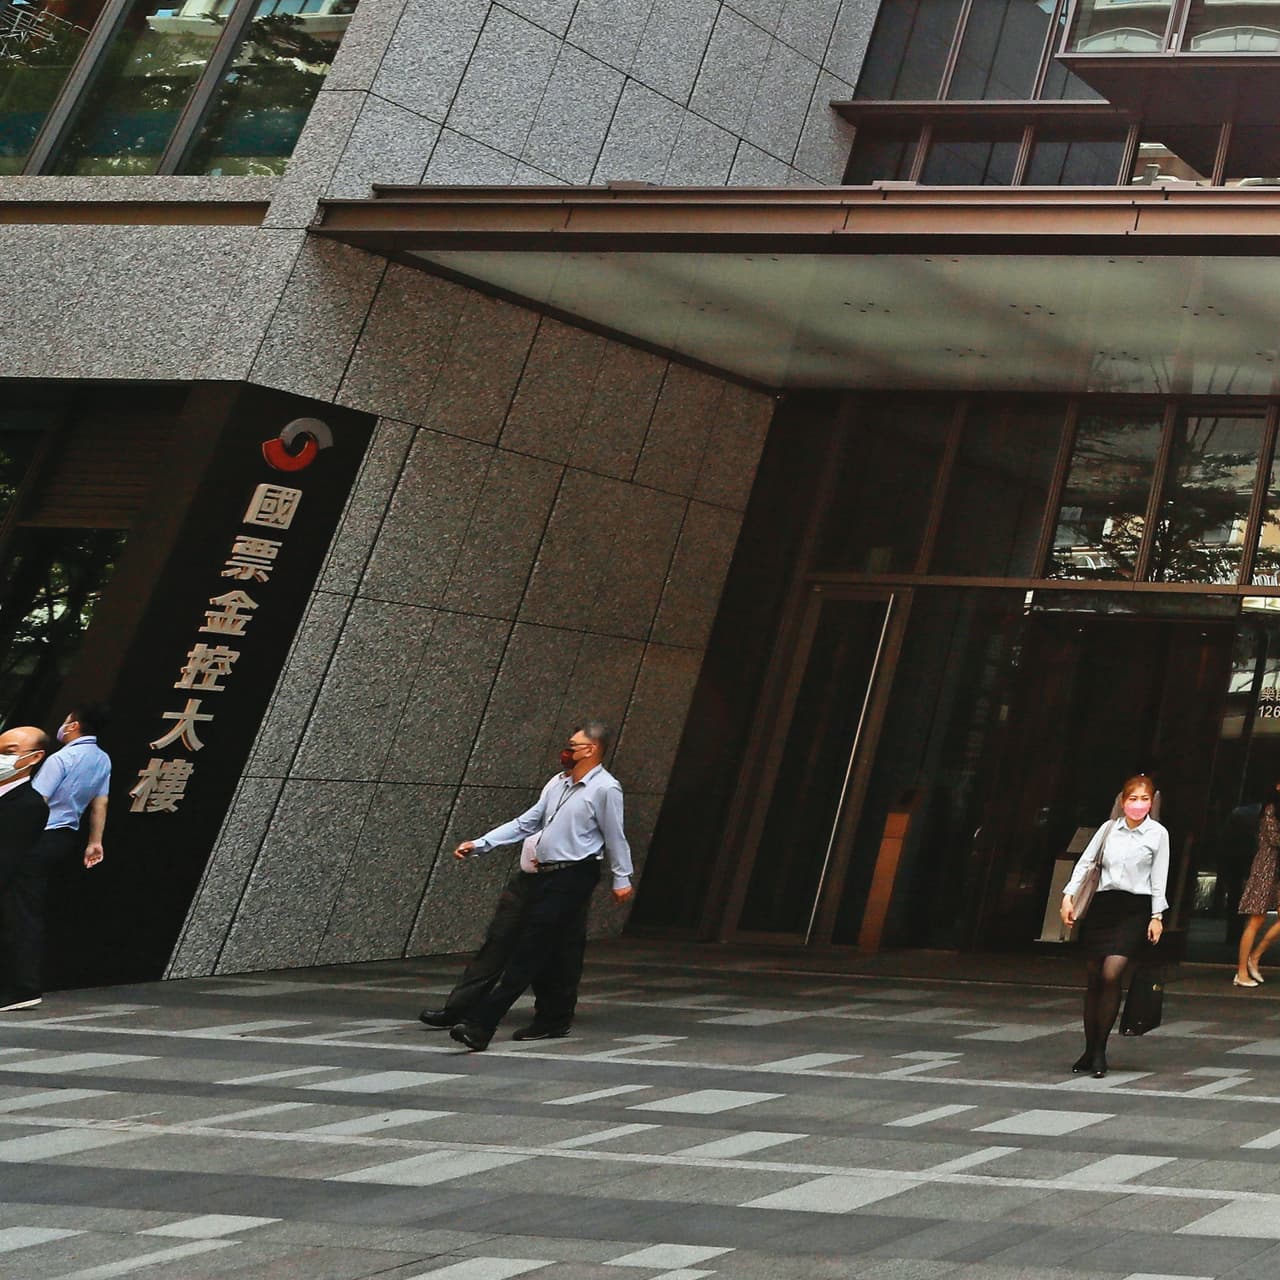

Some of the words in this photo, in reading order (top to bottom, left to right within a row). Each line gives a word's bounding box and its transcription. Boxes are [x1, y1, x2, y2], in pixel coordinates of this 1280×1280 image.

[128, 482, 303, 813] 國票金控大樓
